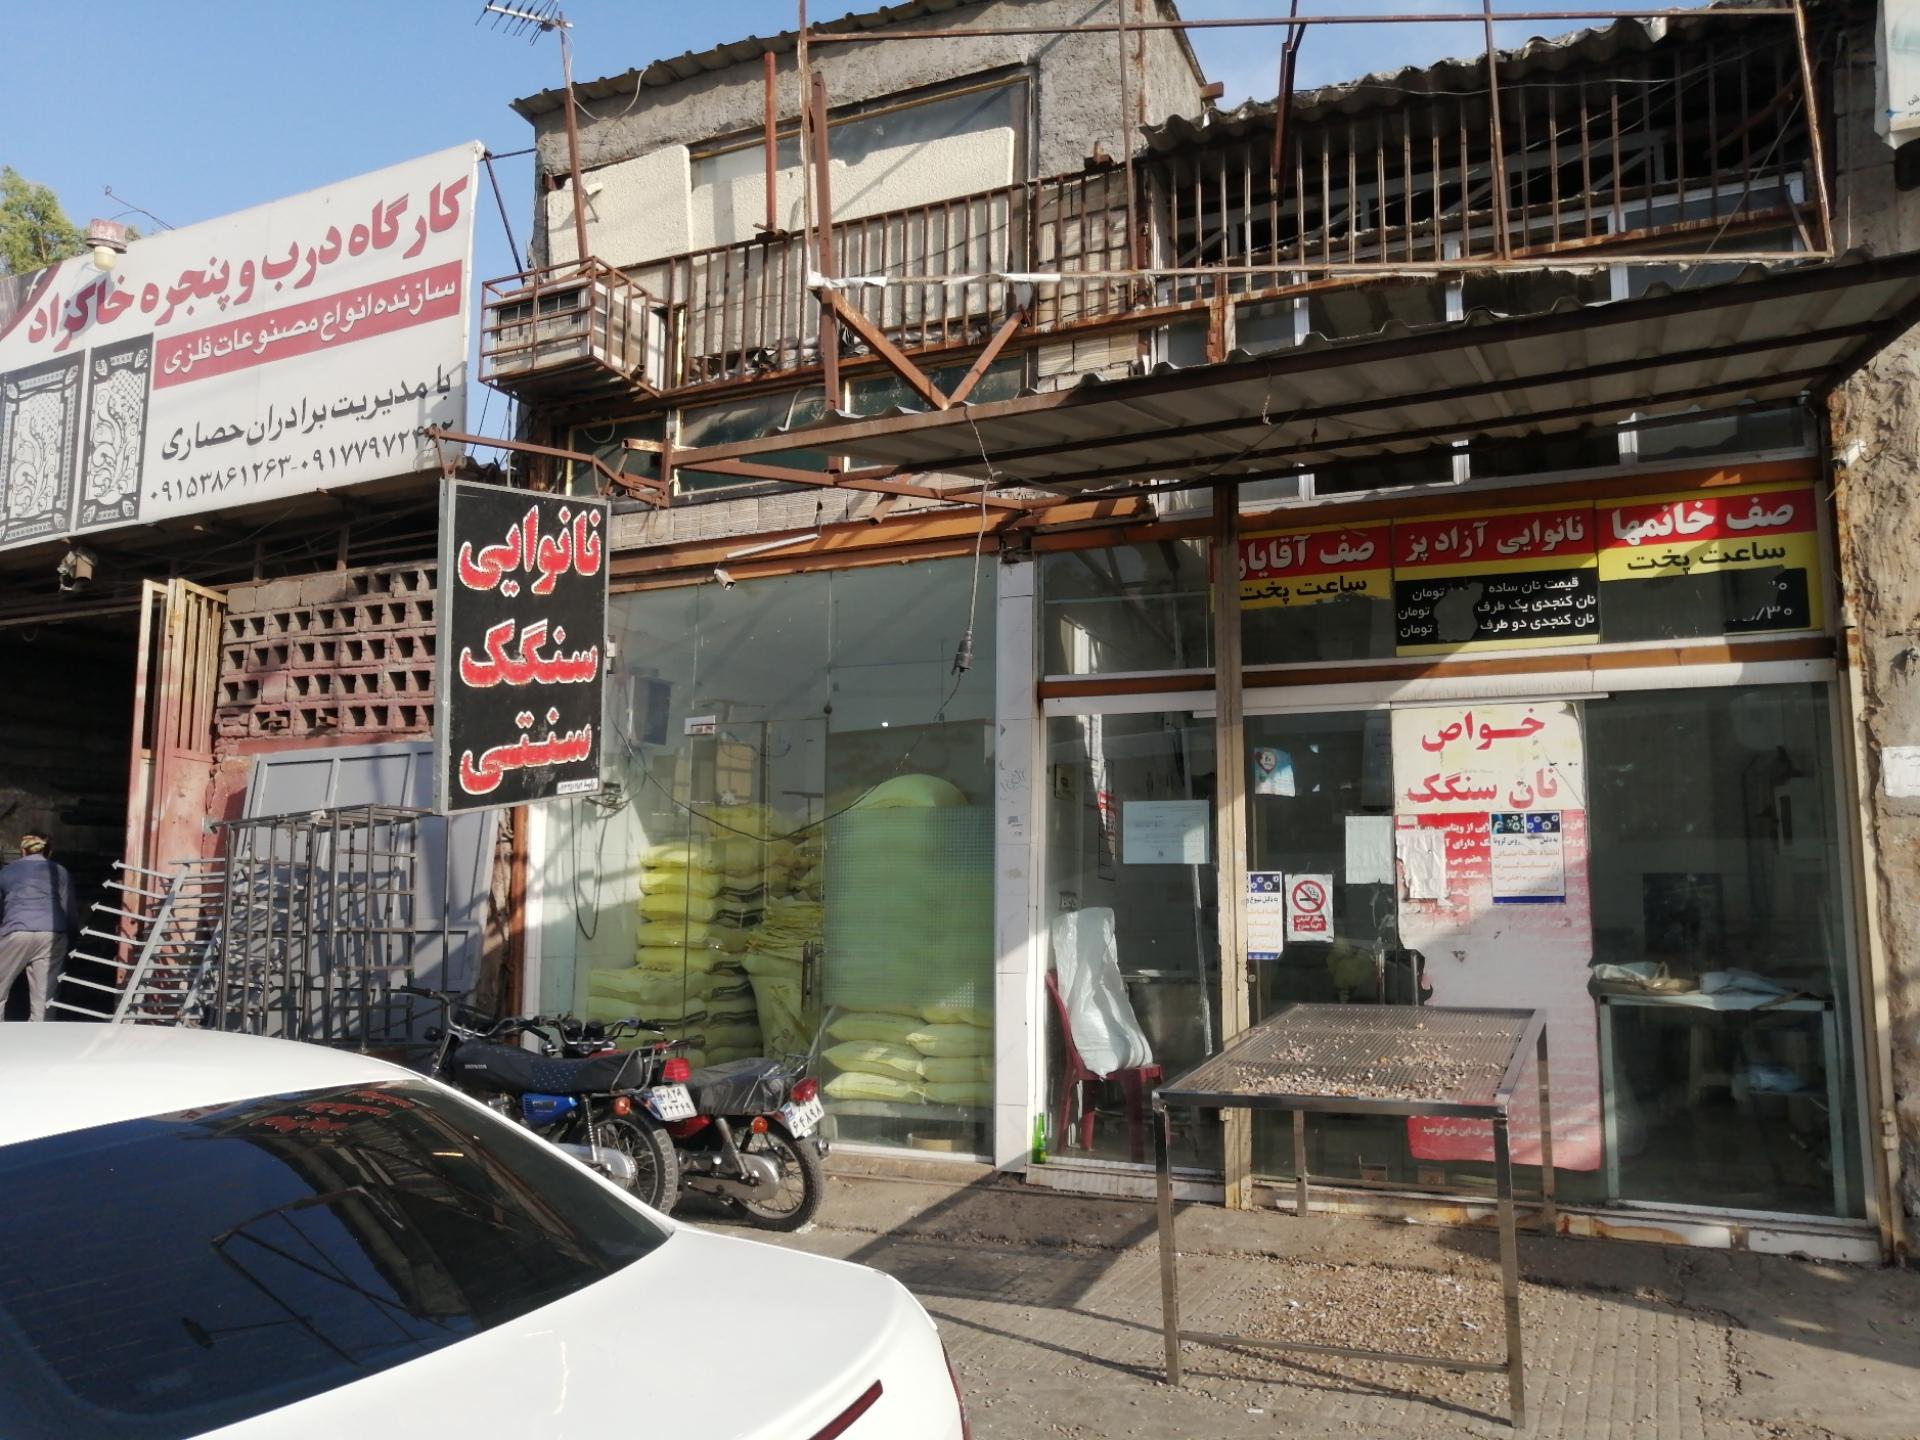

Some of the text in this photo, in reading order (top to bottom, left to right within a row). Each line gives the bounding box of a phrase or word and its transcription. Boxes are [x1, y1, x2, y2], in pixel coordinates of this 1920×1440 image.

[28, 174, 468, 352] کارگاه درب و پنجره خاکزاد
[164, 277, 456, 374] سازنده انواع مصنوعات فلزی
[161, 363, 451, 461] با مدیریت برادران حصاری
[1496, 515, 1584, 552] نانوایی
[1611, 497, 1794, 546] صف خانمها
[458, 504, 602, 597] نانوایی
[1319, 533, 1375, 565] صف
[1627, 542, 1786, 575] ساعت پخت
[1240, 575, 1367, 605] ساعت پخت
[1412, 587, 1445, 602] تومان
[1488, 581, 1518, 594] ساده
[1521, 580, 1541, 594] نان
[1544, 576, 1580, 591] قیمت
[1398, 594, 1596, 620] نان کنجدی یک طرف تومان
[1400, 612, 1595, 638] نان کنجدی دو طرف تومان
[459, 618, 598, 688] سنگک
[1421, 707, 1546, 752] خواص
[459, 706, 592, 795] سنتی
[1406, 767, 1558, 809] نان سنگک
